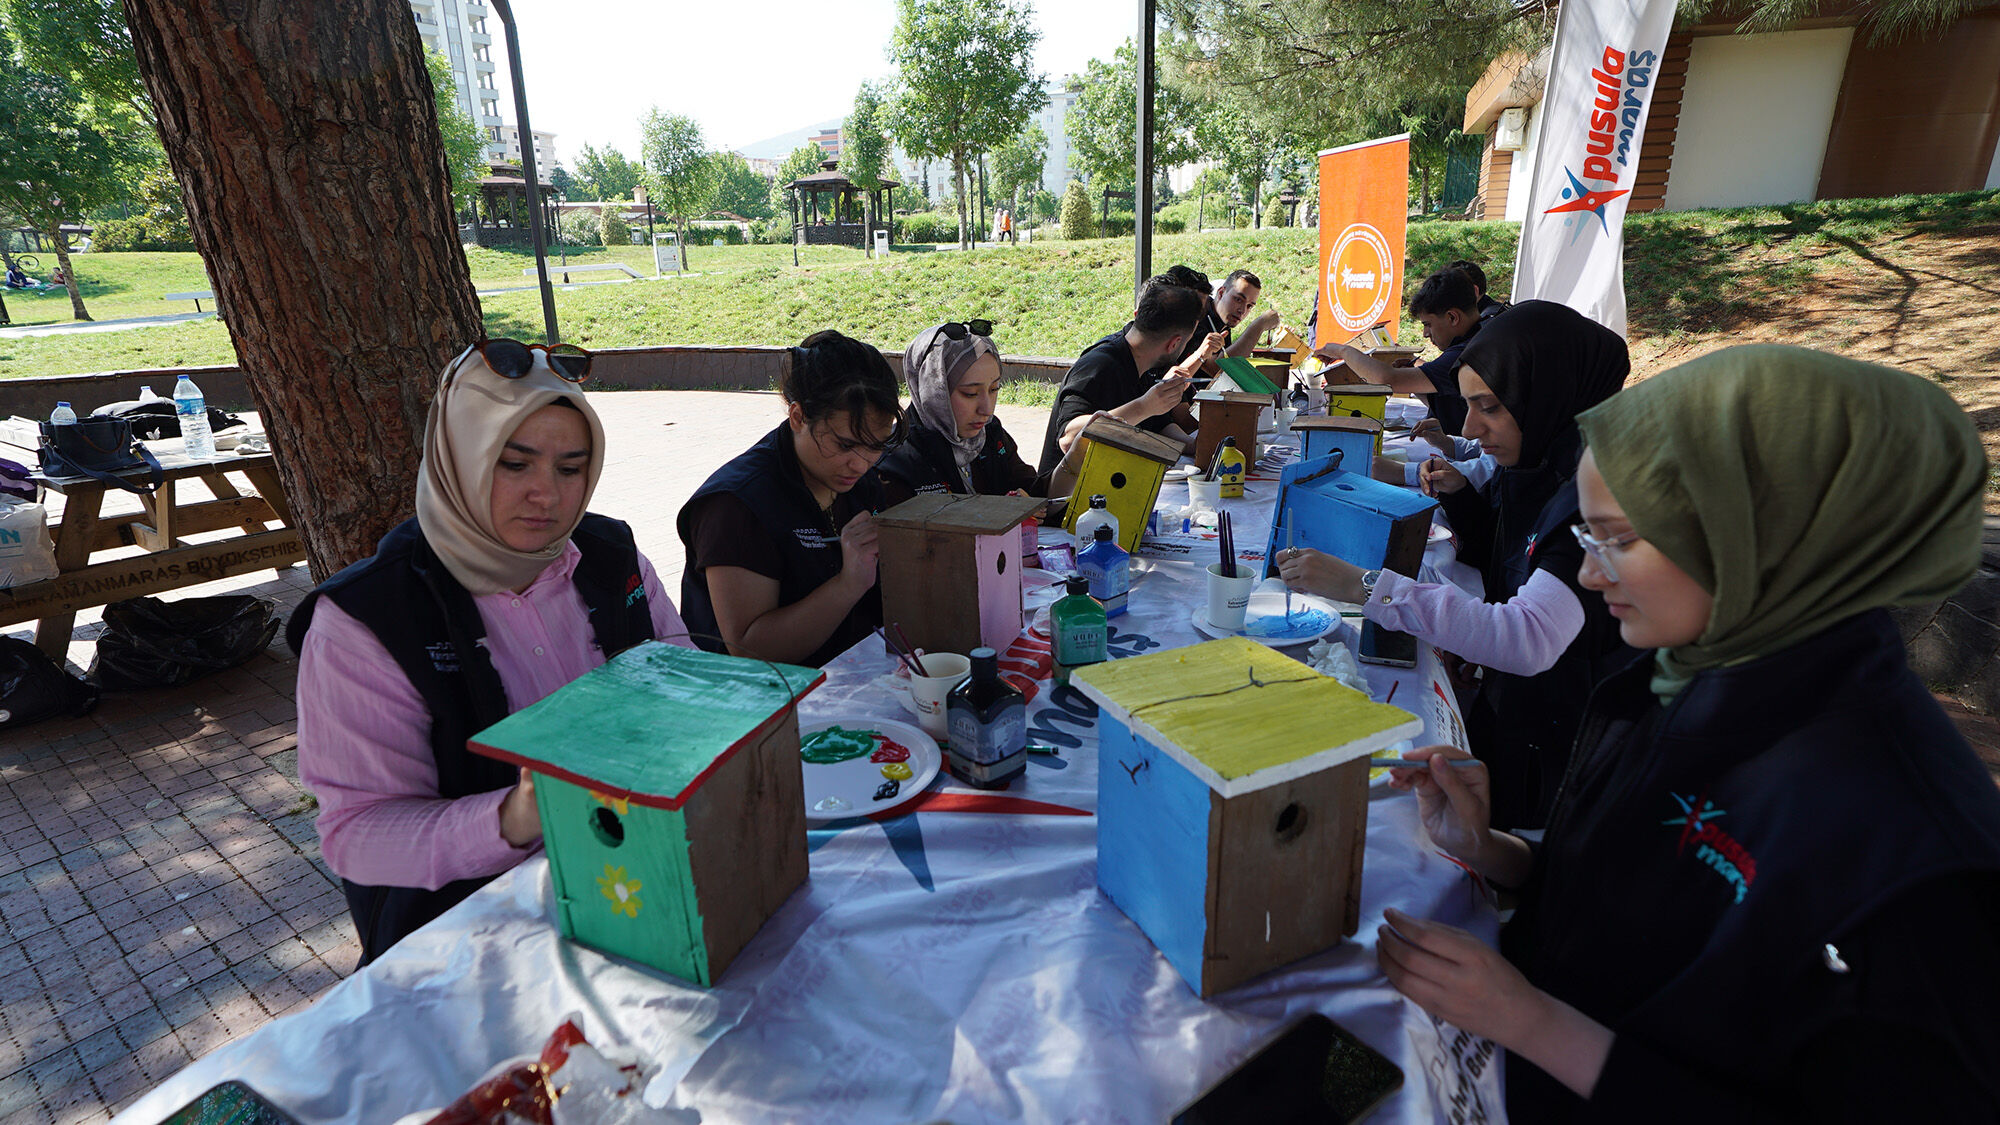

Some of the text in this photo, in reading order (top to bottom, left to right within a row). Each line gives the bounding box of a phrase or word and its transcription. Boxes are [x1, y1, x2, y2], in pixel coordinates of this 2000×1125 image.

[1583, 45, 1626, 183] pusula
[1617, 49, 1657, 167] maraş
[187, 540, 298, 575] BÜYÜKŞEHİR
